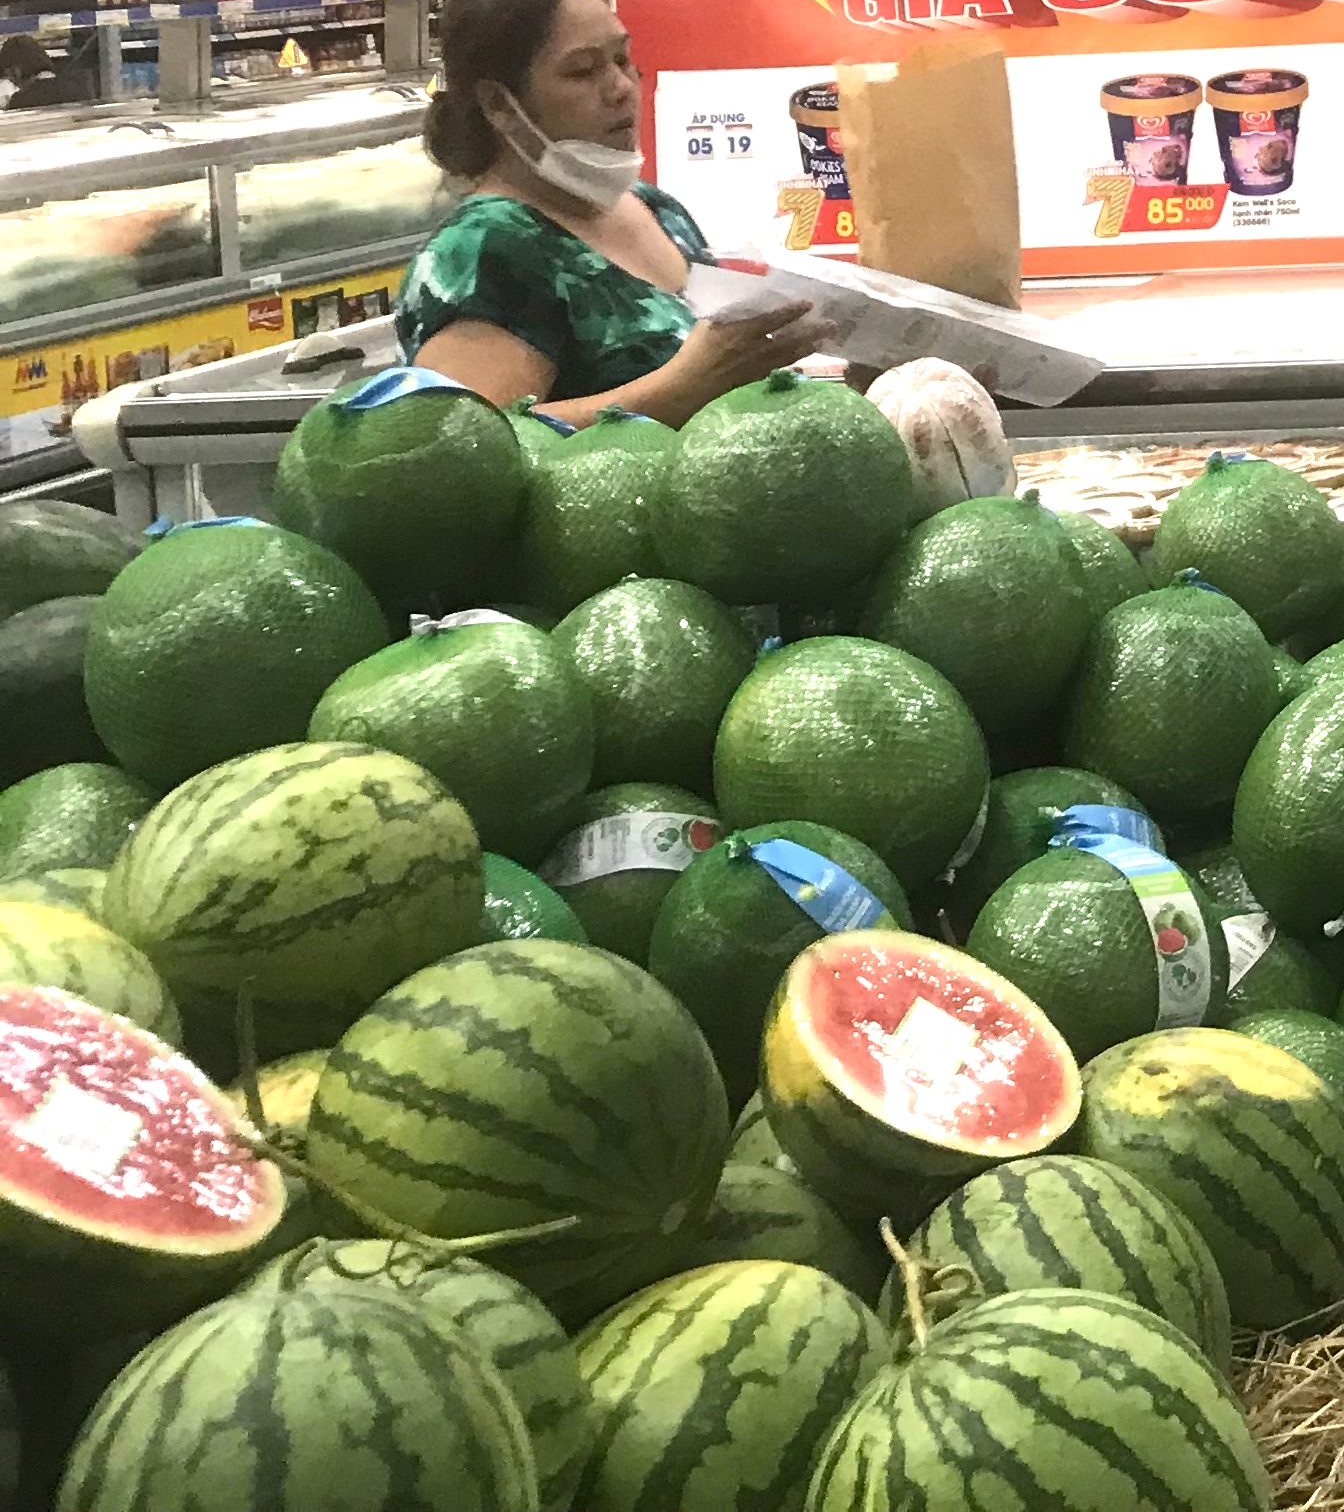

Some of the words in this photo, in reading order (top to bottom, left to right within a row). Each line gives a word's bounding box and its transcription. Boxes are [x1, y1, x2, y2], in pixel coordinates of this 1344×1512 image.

[710, 112, 746, 126] DỤNG
[687, 137, 713, 155] 05
[727, 135, 752, 153] 19
